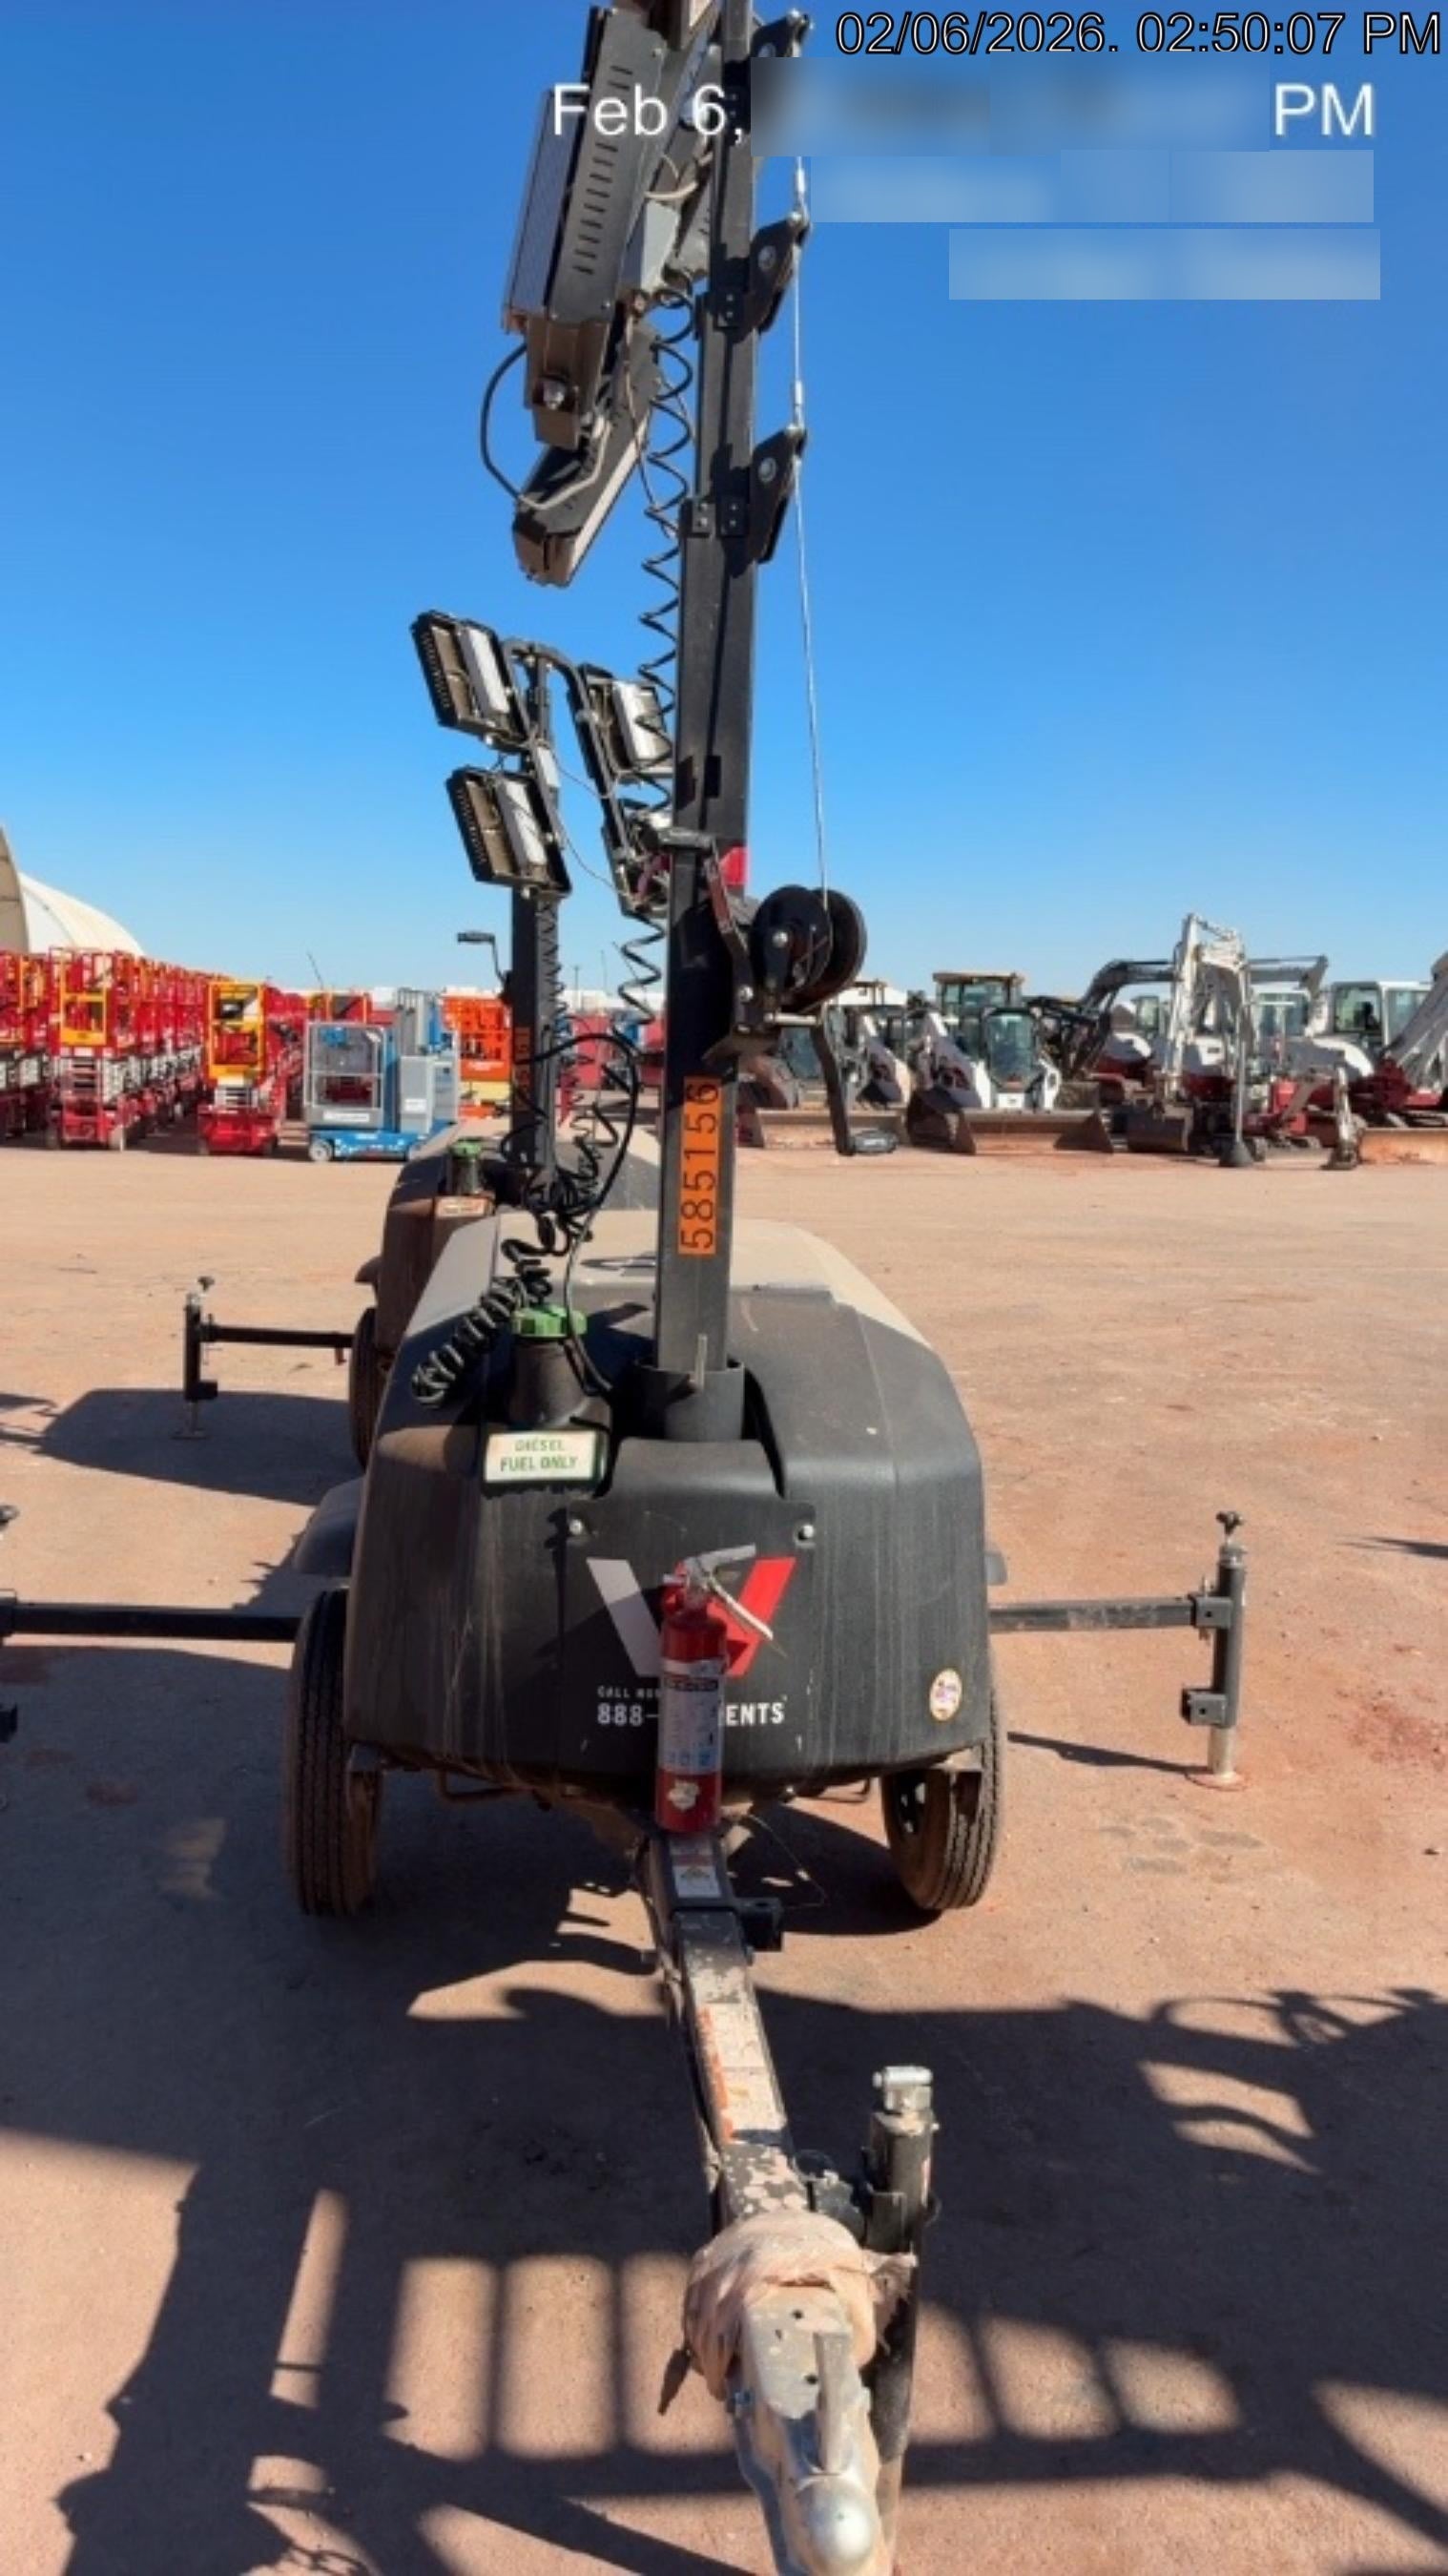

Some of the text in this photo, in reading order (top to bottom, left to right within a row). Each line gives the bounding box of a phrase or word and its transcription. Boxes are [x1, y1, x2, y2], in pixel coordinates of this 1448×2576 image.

[680, 1082, 719, 1250] 585156
[515, 1439, 565, 1452] DIESEL
[500, 1456, 578, 1472] FUEL ONLY
